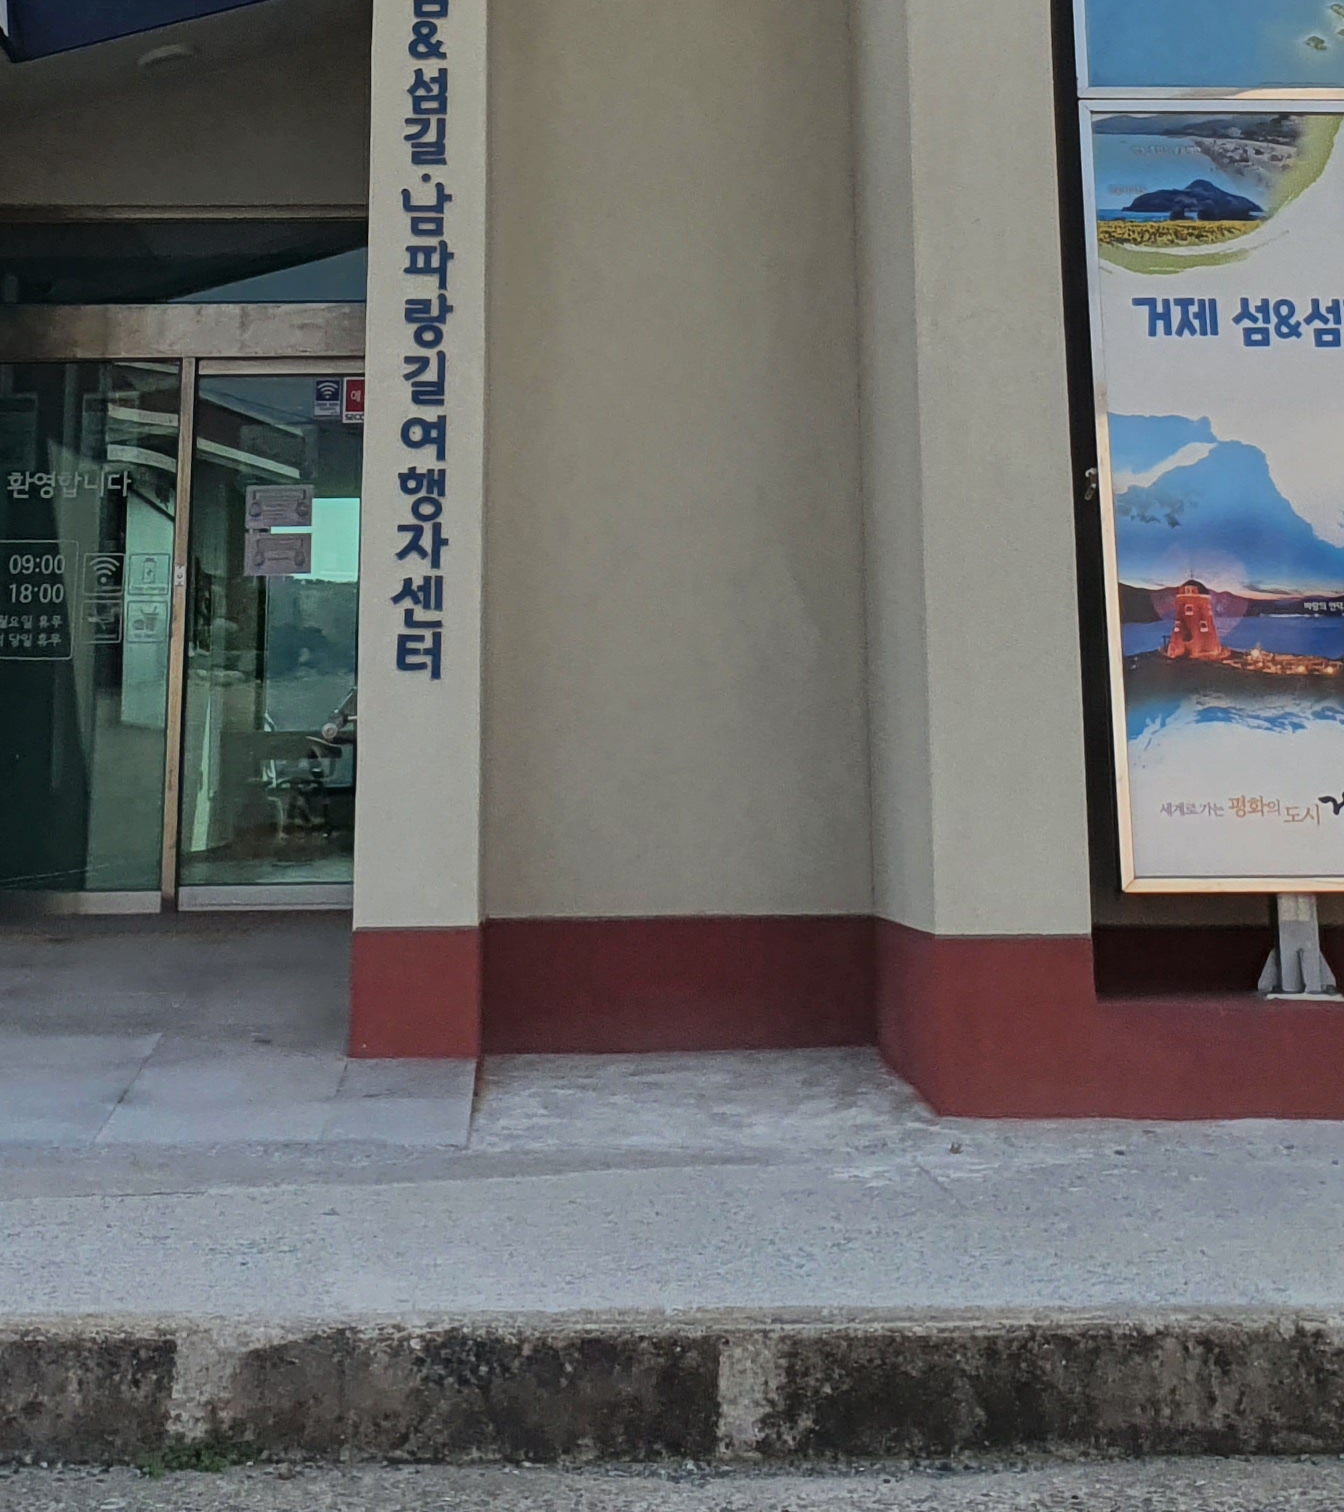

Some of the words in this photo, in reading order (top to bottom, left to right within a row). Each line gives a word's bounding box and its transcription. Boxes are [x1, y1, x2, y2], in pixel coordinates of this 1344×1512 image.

[1132, 297, 1219, 337] 거제
[7, 471, 132, 498] 환영합니다
[9, 555, 65, 574] 09:00
[9, 584, 64, 603] 18:00
[9, 634, 33, 648] 당일
[1228, 795, 1281, 819] 평화의
[1284, 804, 1321, 826] 도시
